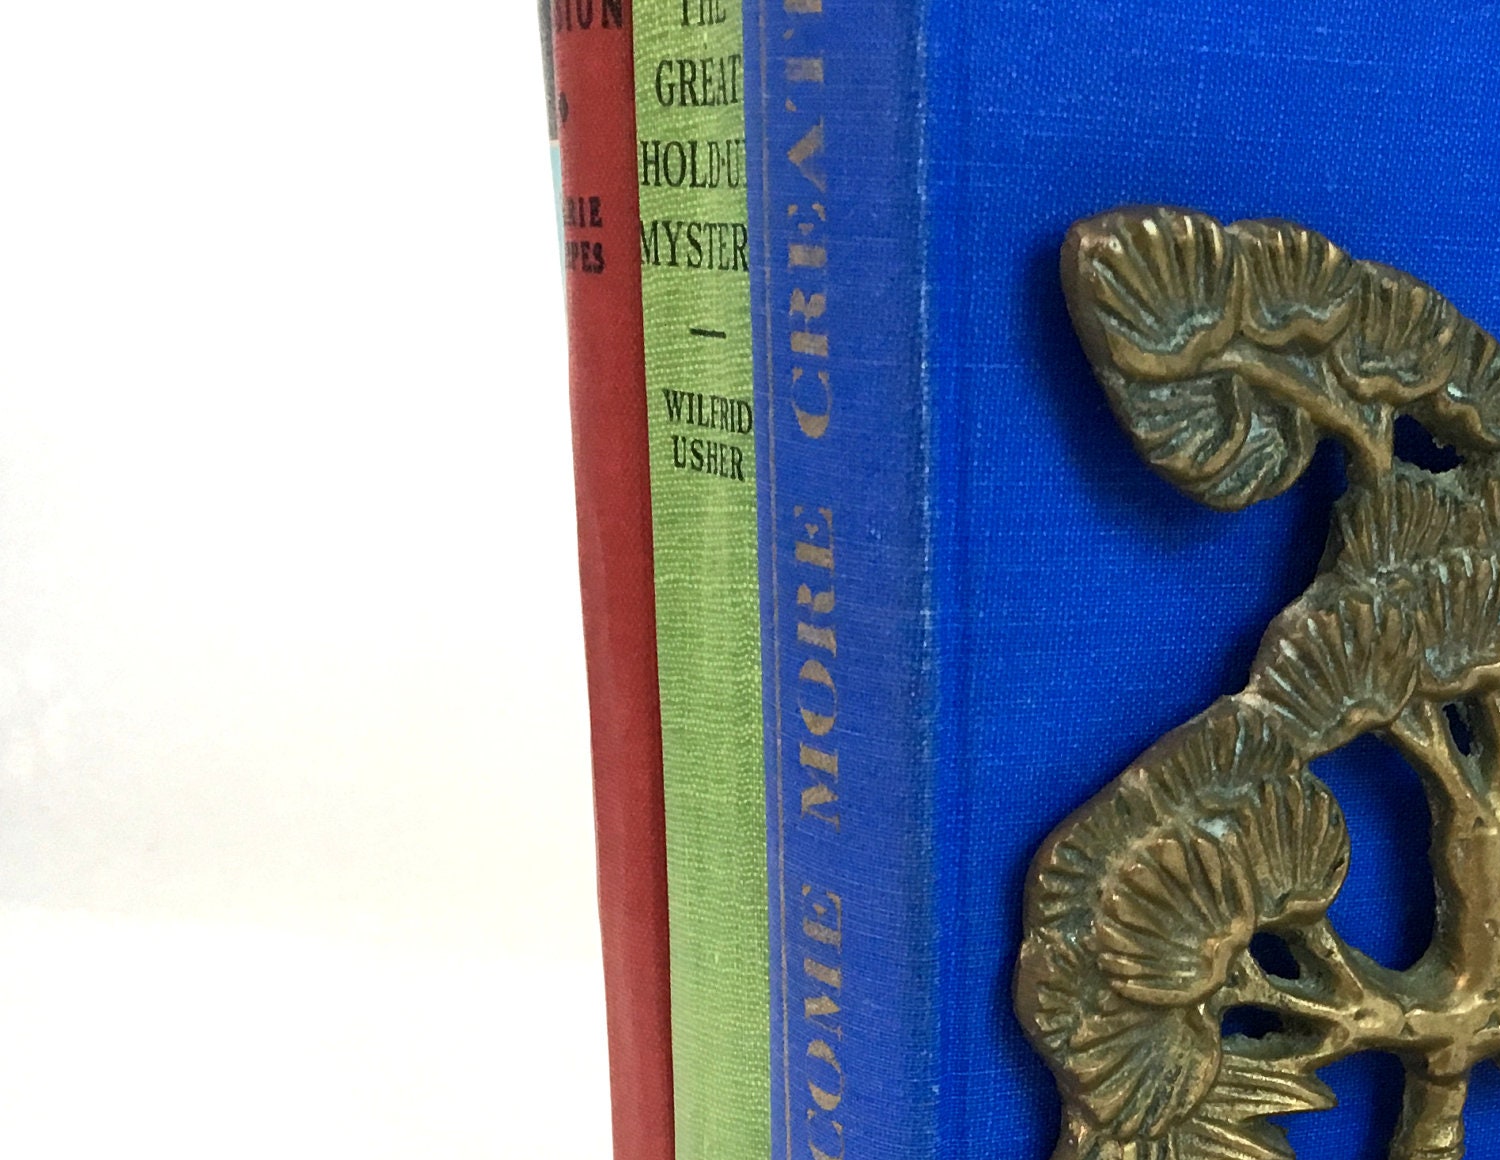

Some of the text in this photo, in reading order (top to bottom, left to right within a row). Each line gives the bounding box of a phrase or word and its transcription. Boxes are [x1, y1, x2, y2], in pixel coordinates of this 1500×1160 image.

[655, 54, 742, 107] GREAT
[640, 139, 746, 188] HOLD-U
[639, 220, 749, 272] MYSTER
[662, 388, 753, 435] WILFRID
[671, 435, 746, 482] USHER
[793, 505, 840, 833] MORE
